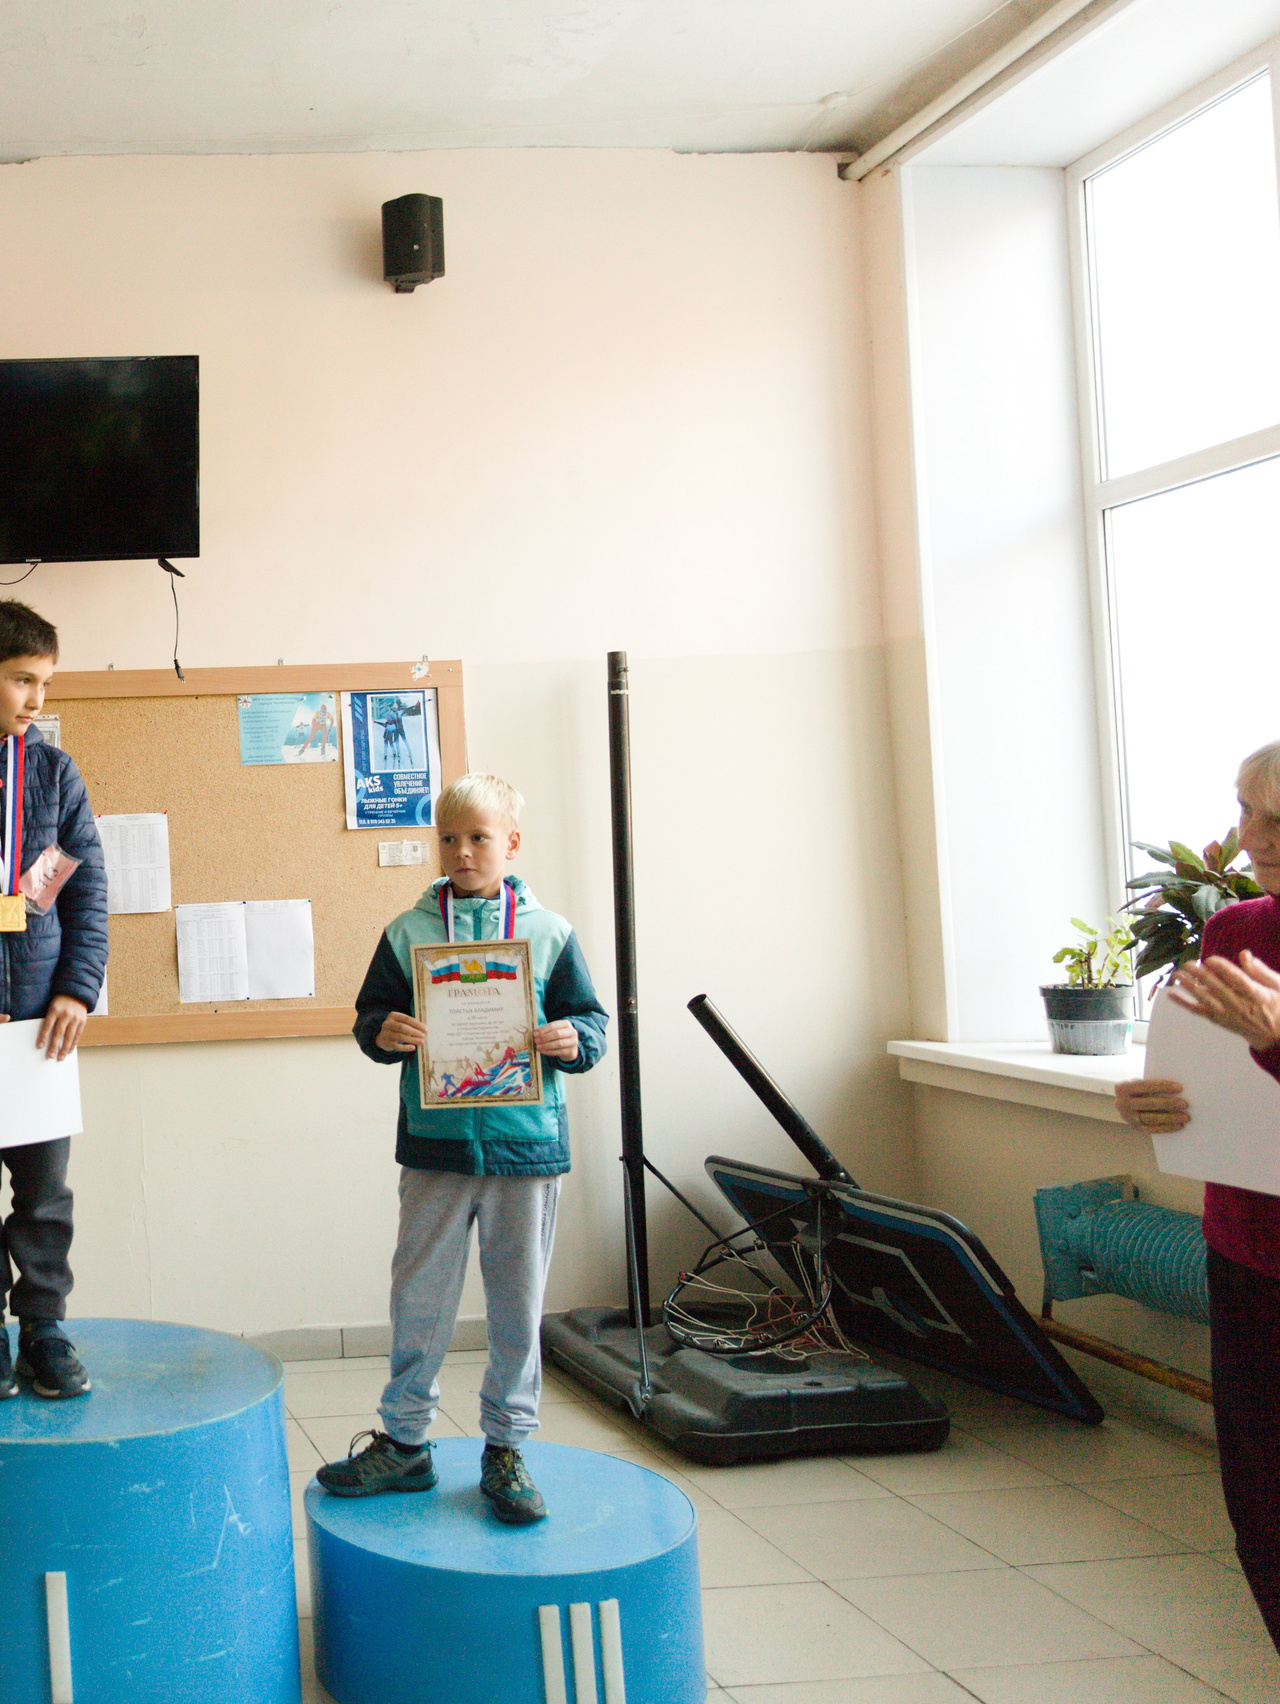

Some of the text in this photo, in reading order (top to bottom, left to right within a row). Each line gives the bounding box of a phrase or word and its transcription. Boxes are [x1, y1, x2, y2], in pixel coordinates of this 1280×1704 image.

[357, 776, 381, 789] AKS
[368, 786, 384, 794] kids
[448, 987, 501, 997] ГРАМОТА
